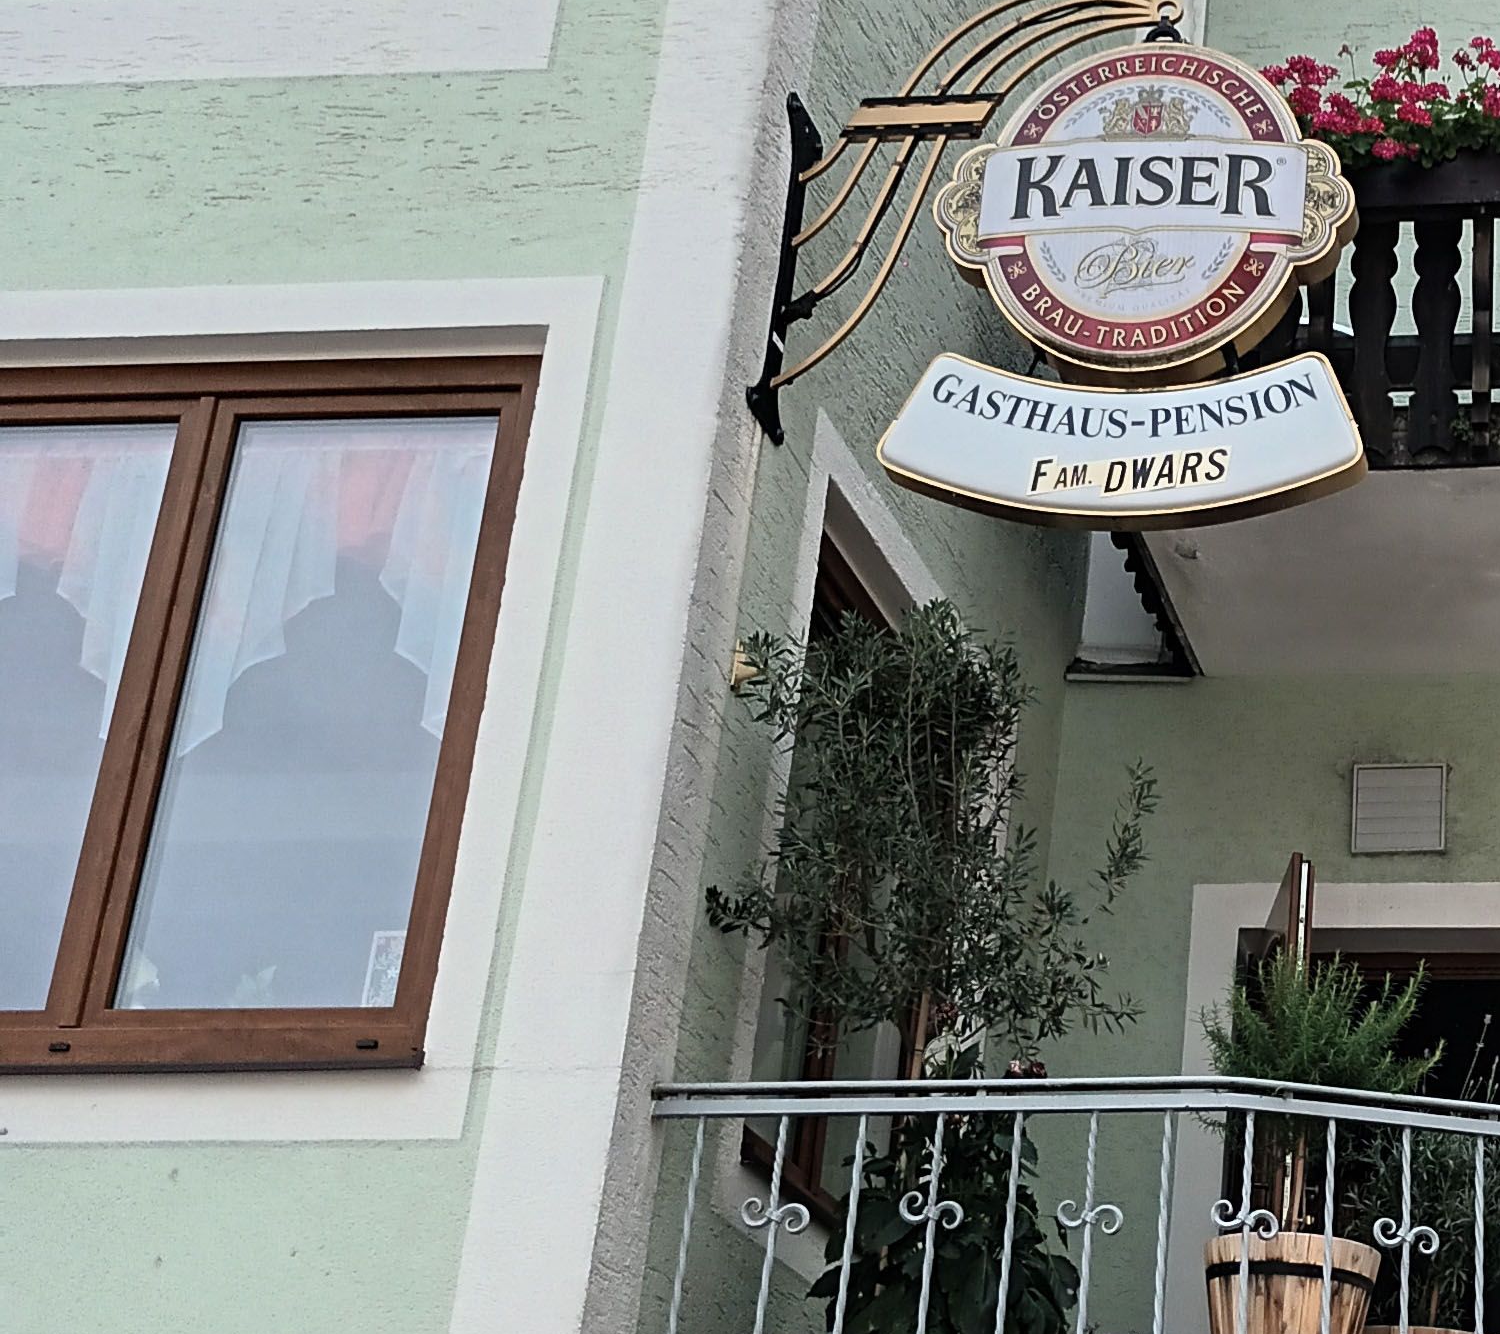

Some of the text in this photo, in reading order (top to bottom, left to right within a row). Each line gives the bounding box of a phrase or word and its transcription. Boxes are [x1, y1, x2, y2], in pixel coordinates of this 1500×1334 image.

[1034, 55, 1264, 120] ÖSTERREICHISCHE
[1009, 153, 1277, 220] KAISER
[1073, 239, 1195, 299] Bier
[1020, 280, 1247, 347] BRAU-TRADITION
[932, 372, 1319, 439] GASTHAUS-PENSION
[1103, 448, 1230, 494] DWARS
